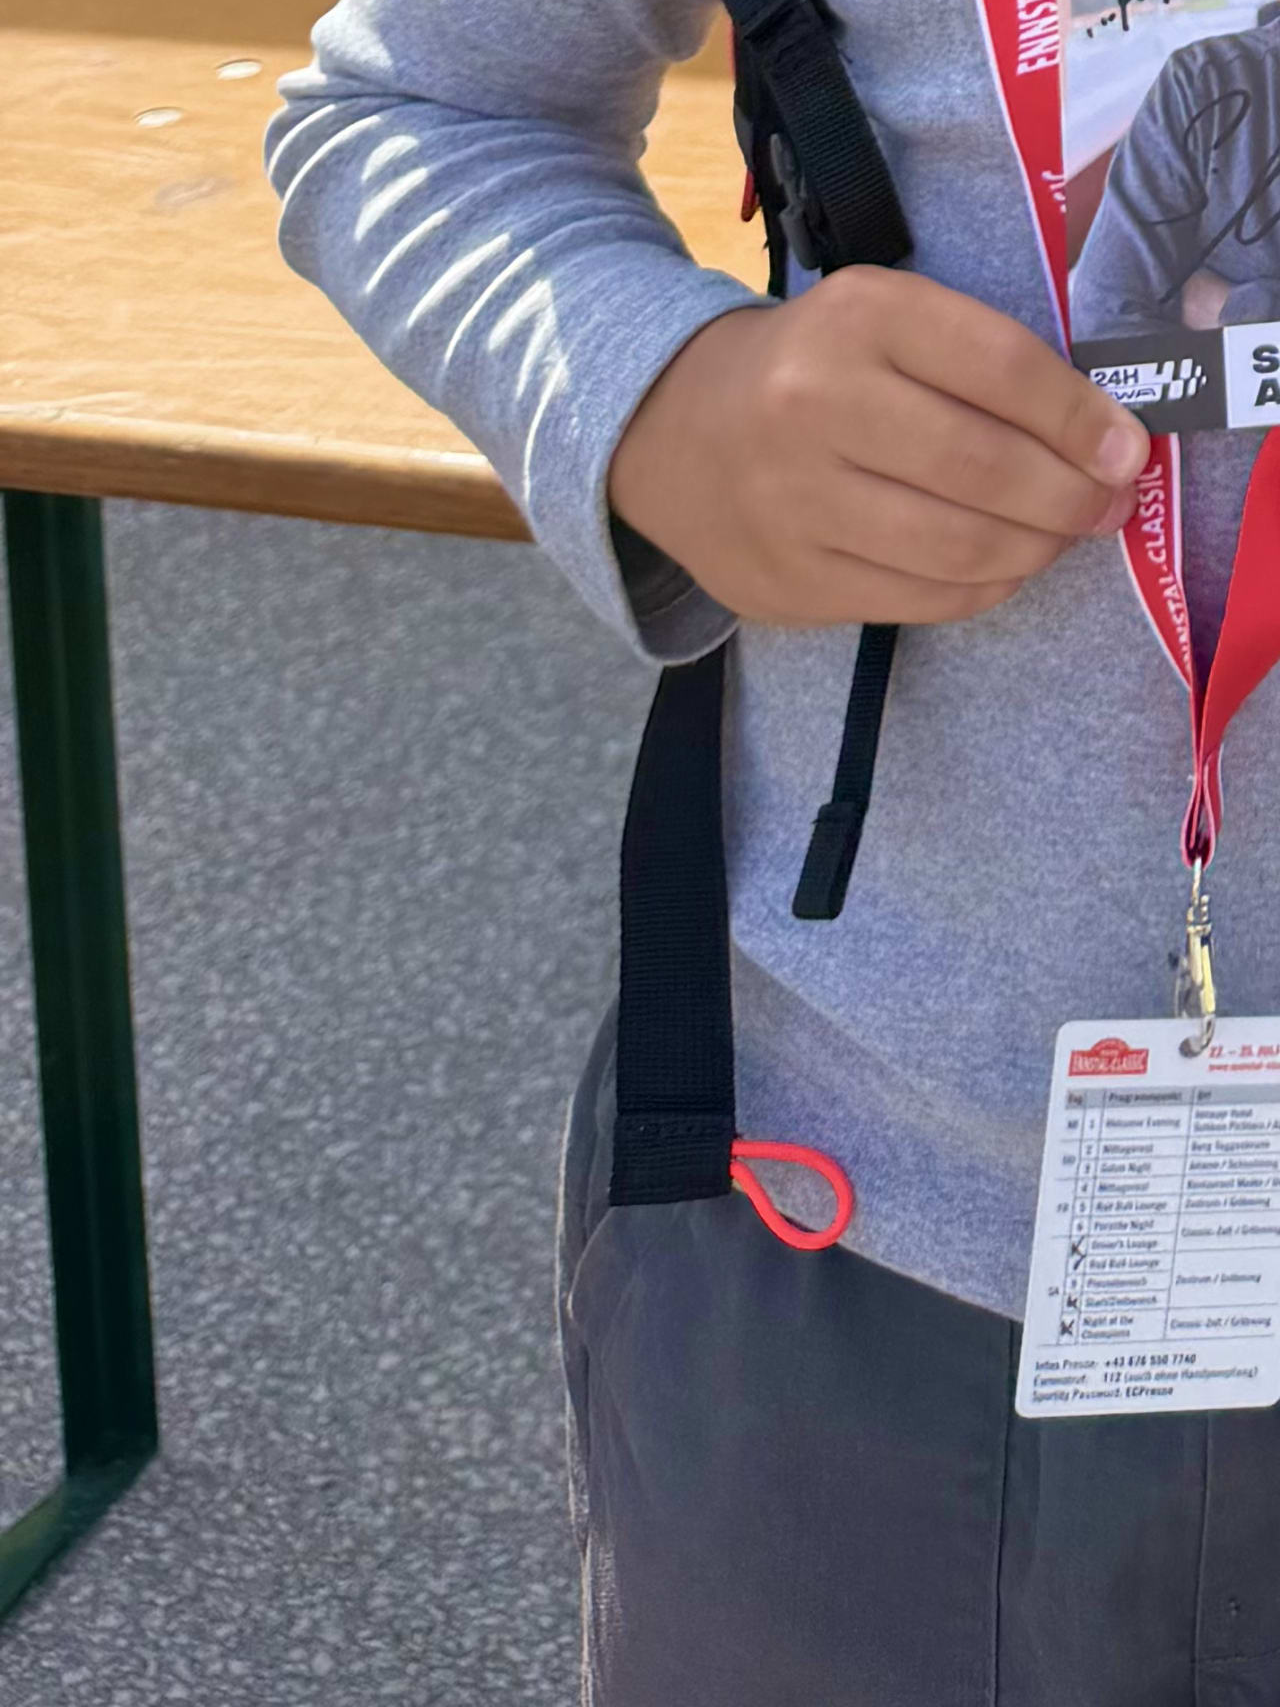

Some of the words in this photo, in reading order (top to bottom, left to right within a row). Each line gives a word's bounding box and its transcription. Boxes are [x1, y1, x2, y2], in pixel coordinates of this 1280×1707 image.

[1094, 368, 1140, 387] 24H
[1146, 1117, 1181, 1129] Evening
[1130, 1219, 1154, 1230] Night
[1083, 1317, 1107, 1328] Night
[1105, 1357, 1125, 1368] +43
[1128, 1356, 1147, 1367] 676
[1103, 1372, 1121, 1383] 112
[1154, 1371, 1178, 1382] ohne
[1125, 1386, 1174, 1398] ECPresse
